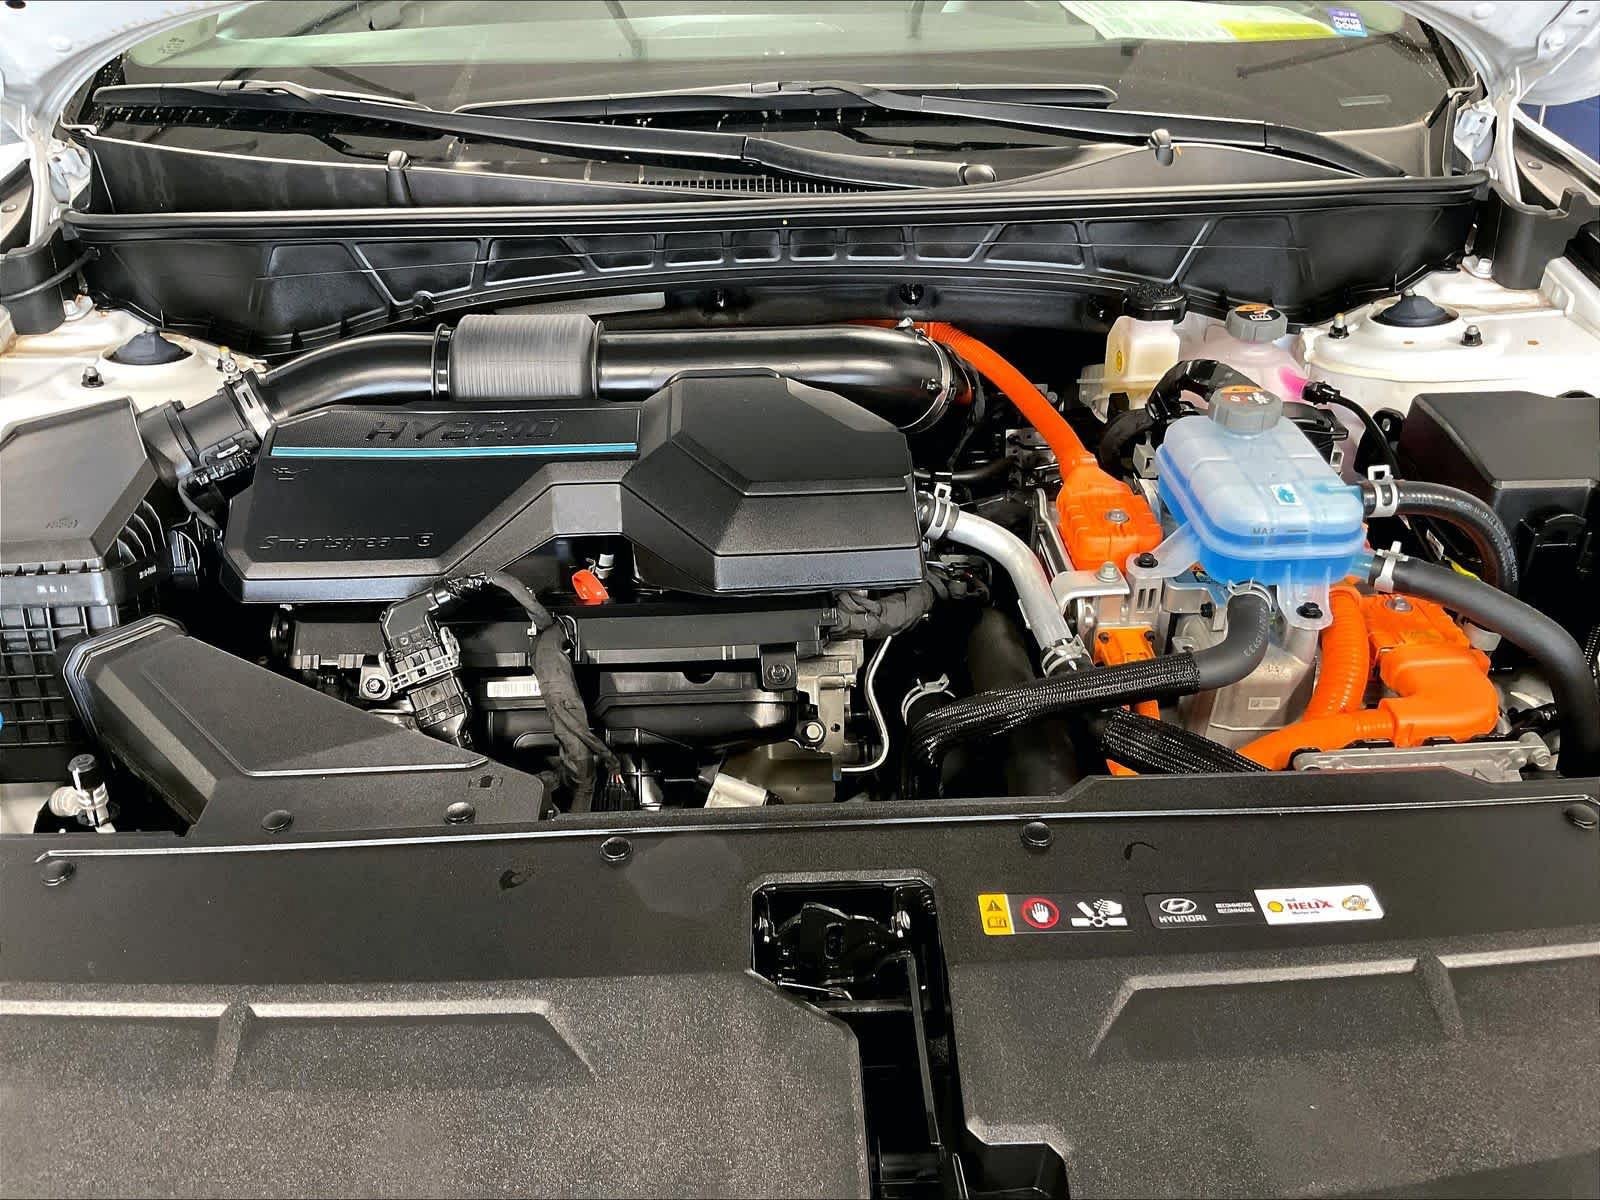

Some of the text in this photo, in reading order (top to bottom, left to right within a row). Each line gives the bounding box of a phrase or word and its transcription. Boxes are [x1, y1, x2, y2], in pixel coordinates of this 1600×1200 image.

[364, 417, 564, 441] HYBRID
[258, 534, 411, 551] Smartstream
[1287, 898, 1334, 910] HELIX
[1158, 914, 1208, 923] HYUNDAI
